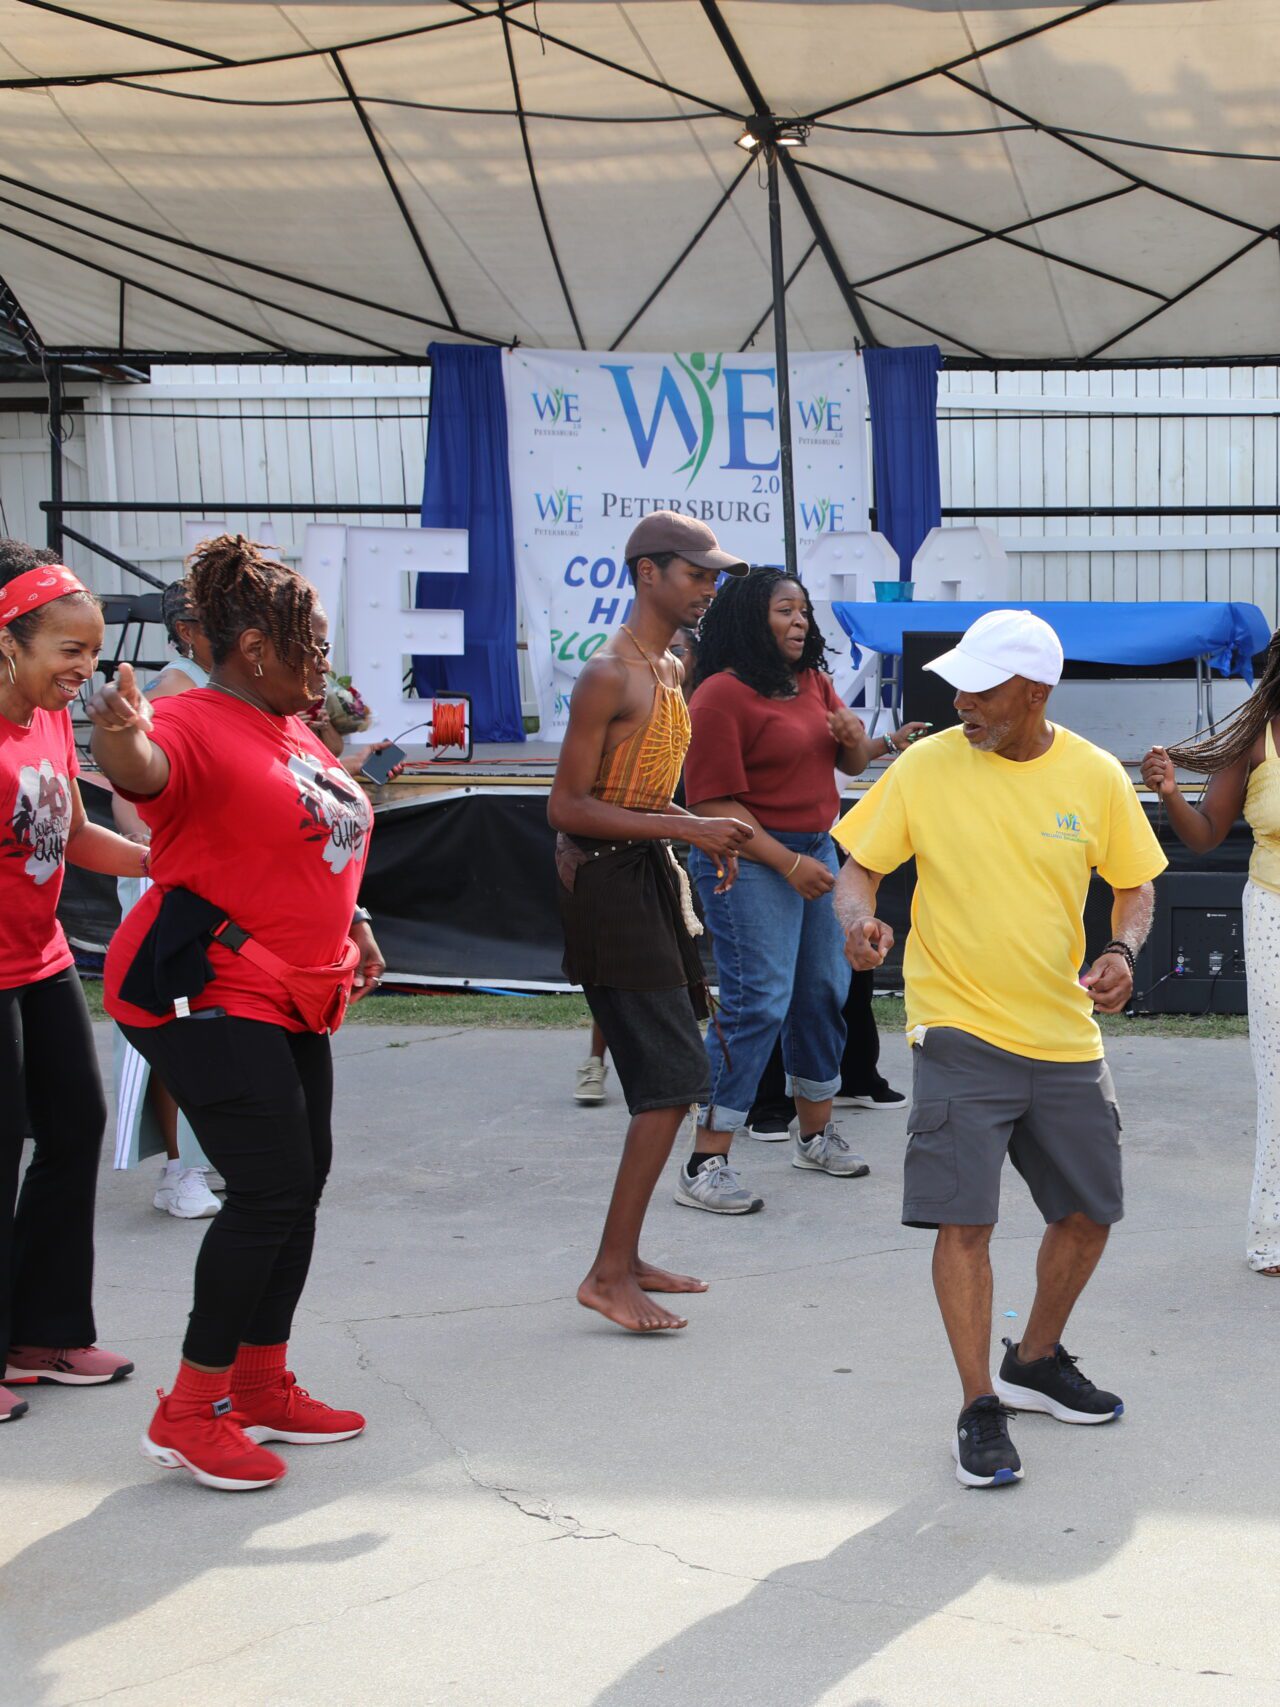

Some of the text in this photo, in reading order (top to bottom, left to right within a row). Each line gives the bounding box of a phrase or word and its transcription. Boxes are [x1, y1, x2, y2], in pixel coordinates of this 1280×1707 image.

[530, 392, 582, 423] WE
[599, 364, 781, 471] WE
[796, 401, 844, 432] WE
[533, 427, 579, 437] PETERSBURG
[798, 437, 841, 446] PETERSBURG
[751, 474, 780, 494] 2.0
[534, 493, 584, 523] WE
[601, 492, 771, 523] PETERSBURG
[800, 503, 845, 532] WE
[533, 527, 580, 537] PETERSBURG
